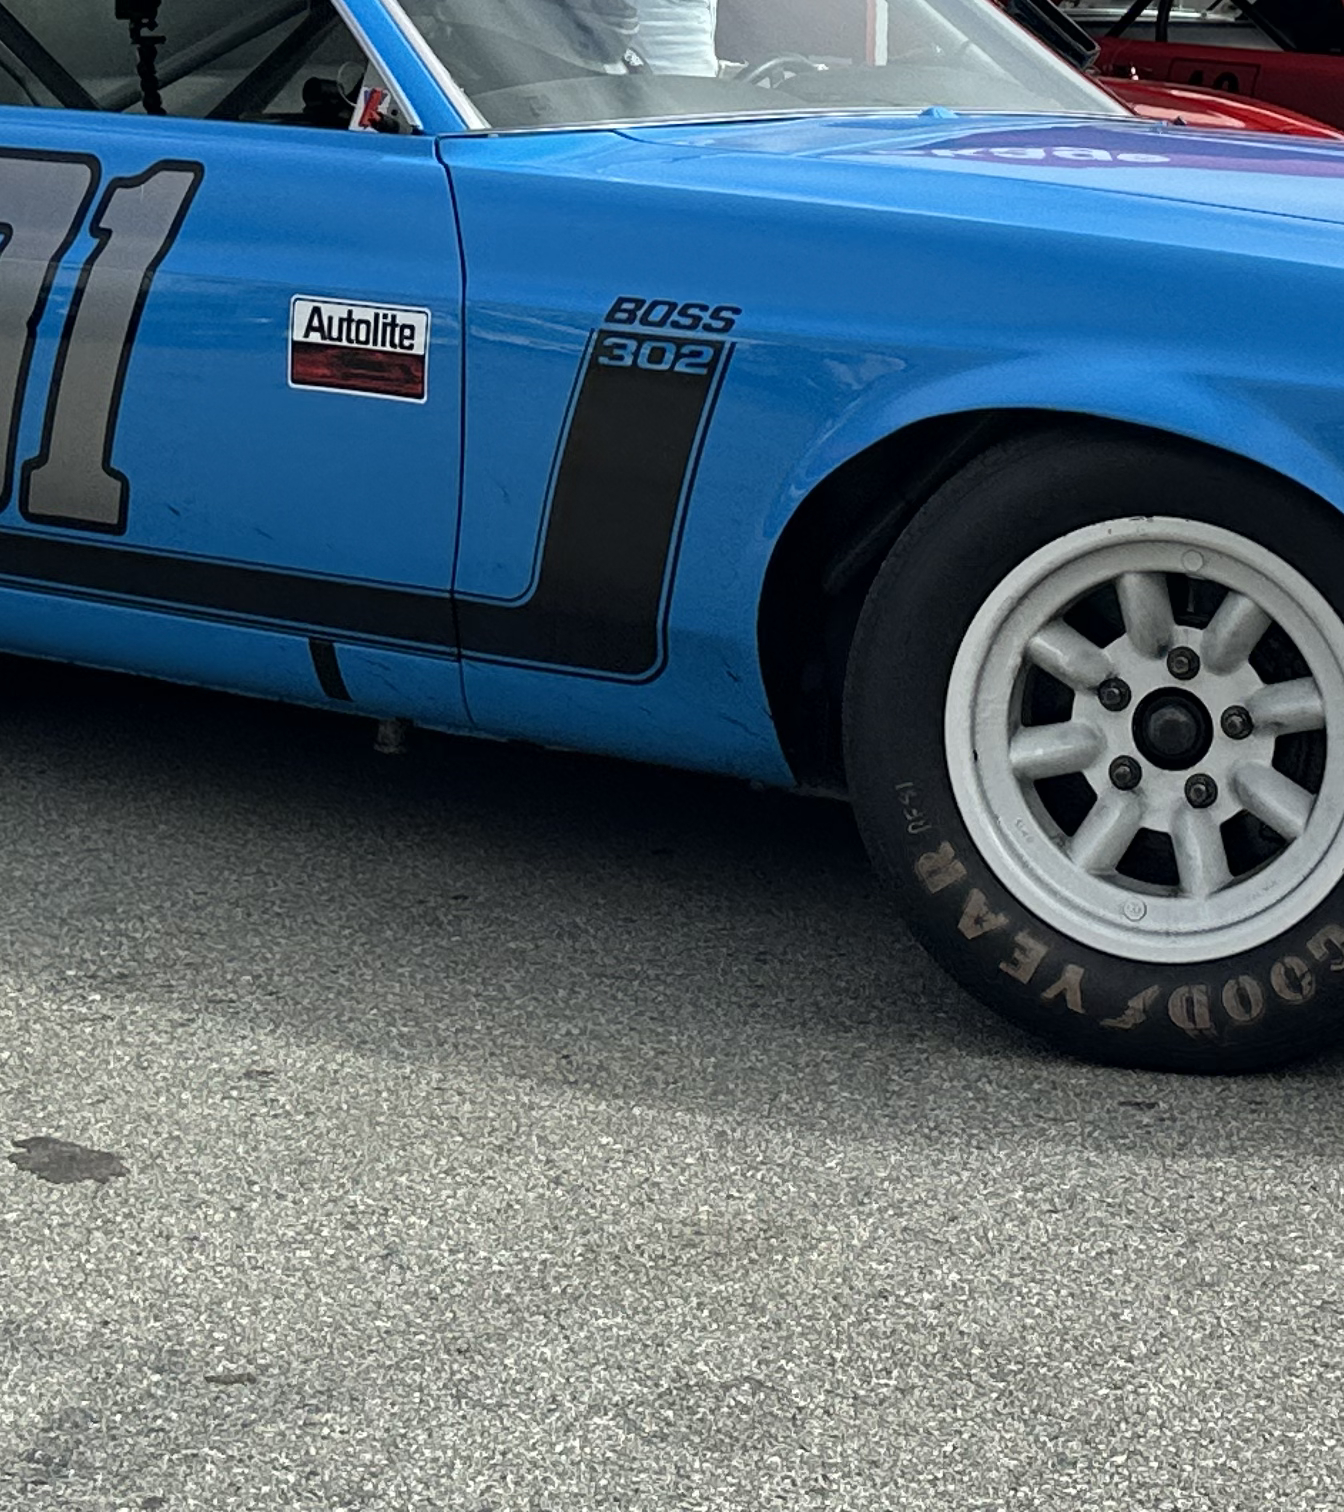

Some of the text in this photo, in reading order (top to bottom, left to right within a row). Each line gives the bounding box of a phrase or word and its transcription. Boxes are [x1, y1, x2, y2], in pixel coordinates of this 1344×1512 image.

[303, 305, 416, 352] Autolite
[605, 296, 742, 333] BOSS
[598, 337, 715, 376] 302
